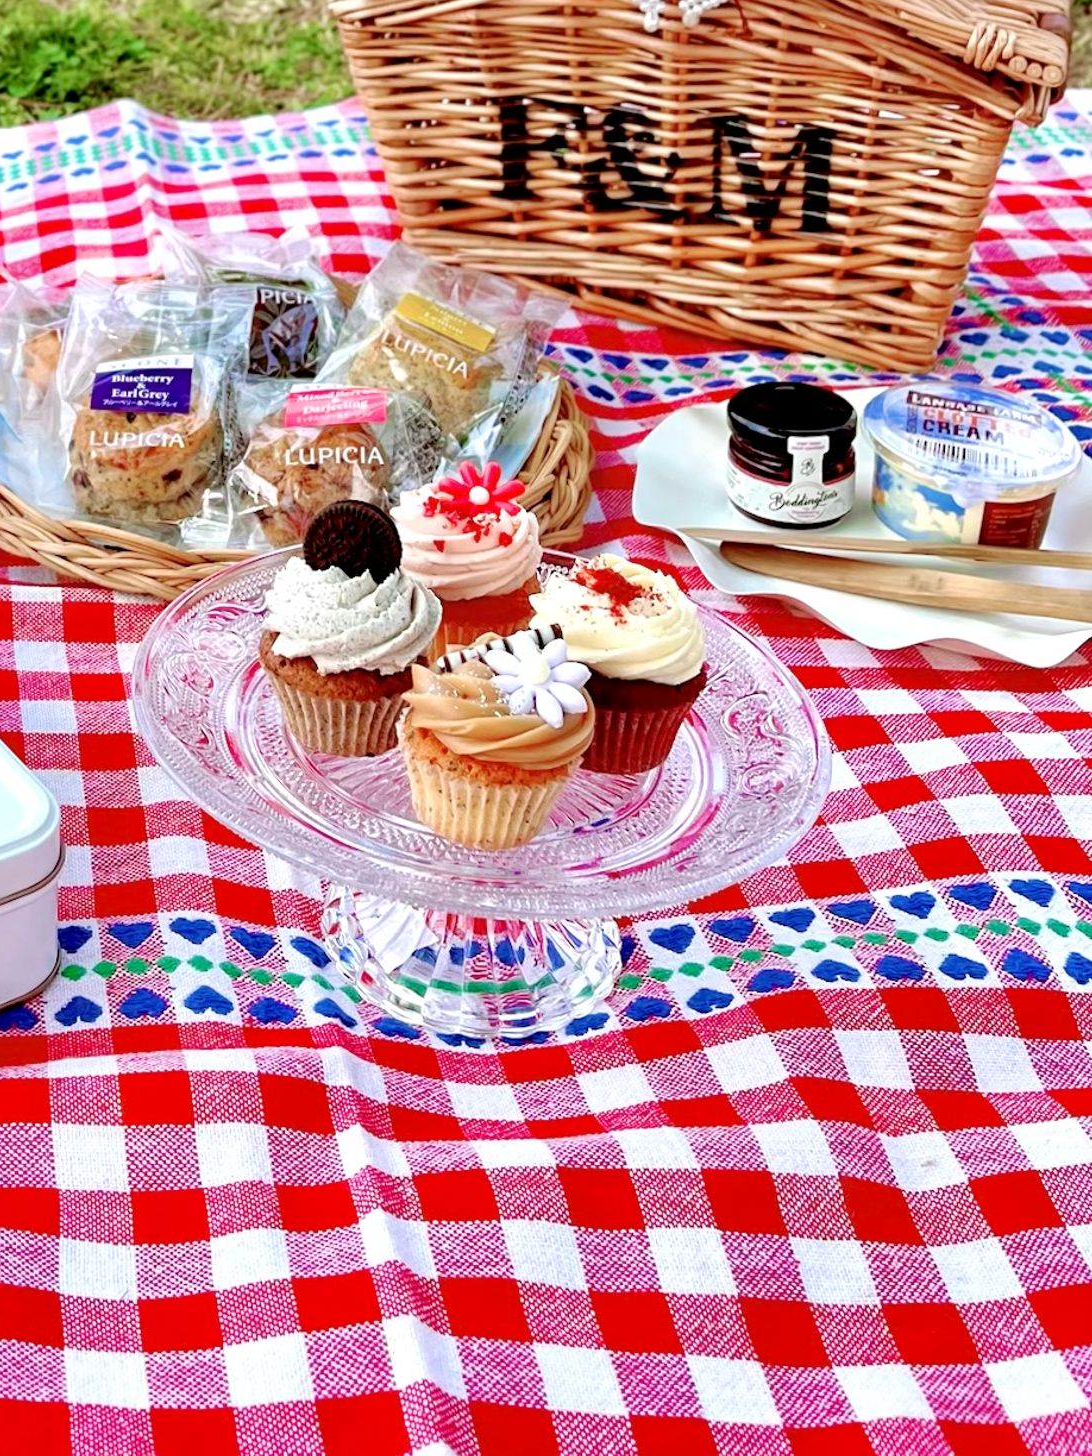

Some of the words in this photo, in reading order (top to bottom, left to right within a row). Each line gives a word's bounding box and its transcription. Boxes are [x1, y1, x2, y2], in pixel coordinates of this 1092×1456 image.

[488, 95, 834, 233] F&M
[381, 329, 469, 379] LUPICIA
[111, 374, 174, 385] Blueberry
[111, 389, 138, 398] Earl
[138, 389, 170, 401] Grey
[303, 400, 369, 415] Darjeeling
[90, 430, 185, 449] LUPICIA
[923, 419, 1005, 445] CREAM
[284, 446, 384, 465] LUPICIA
